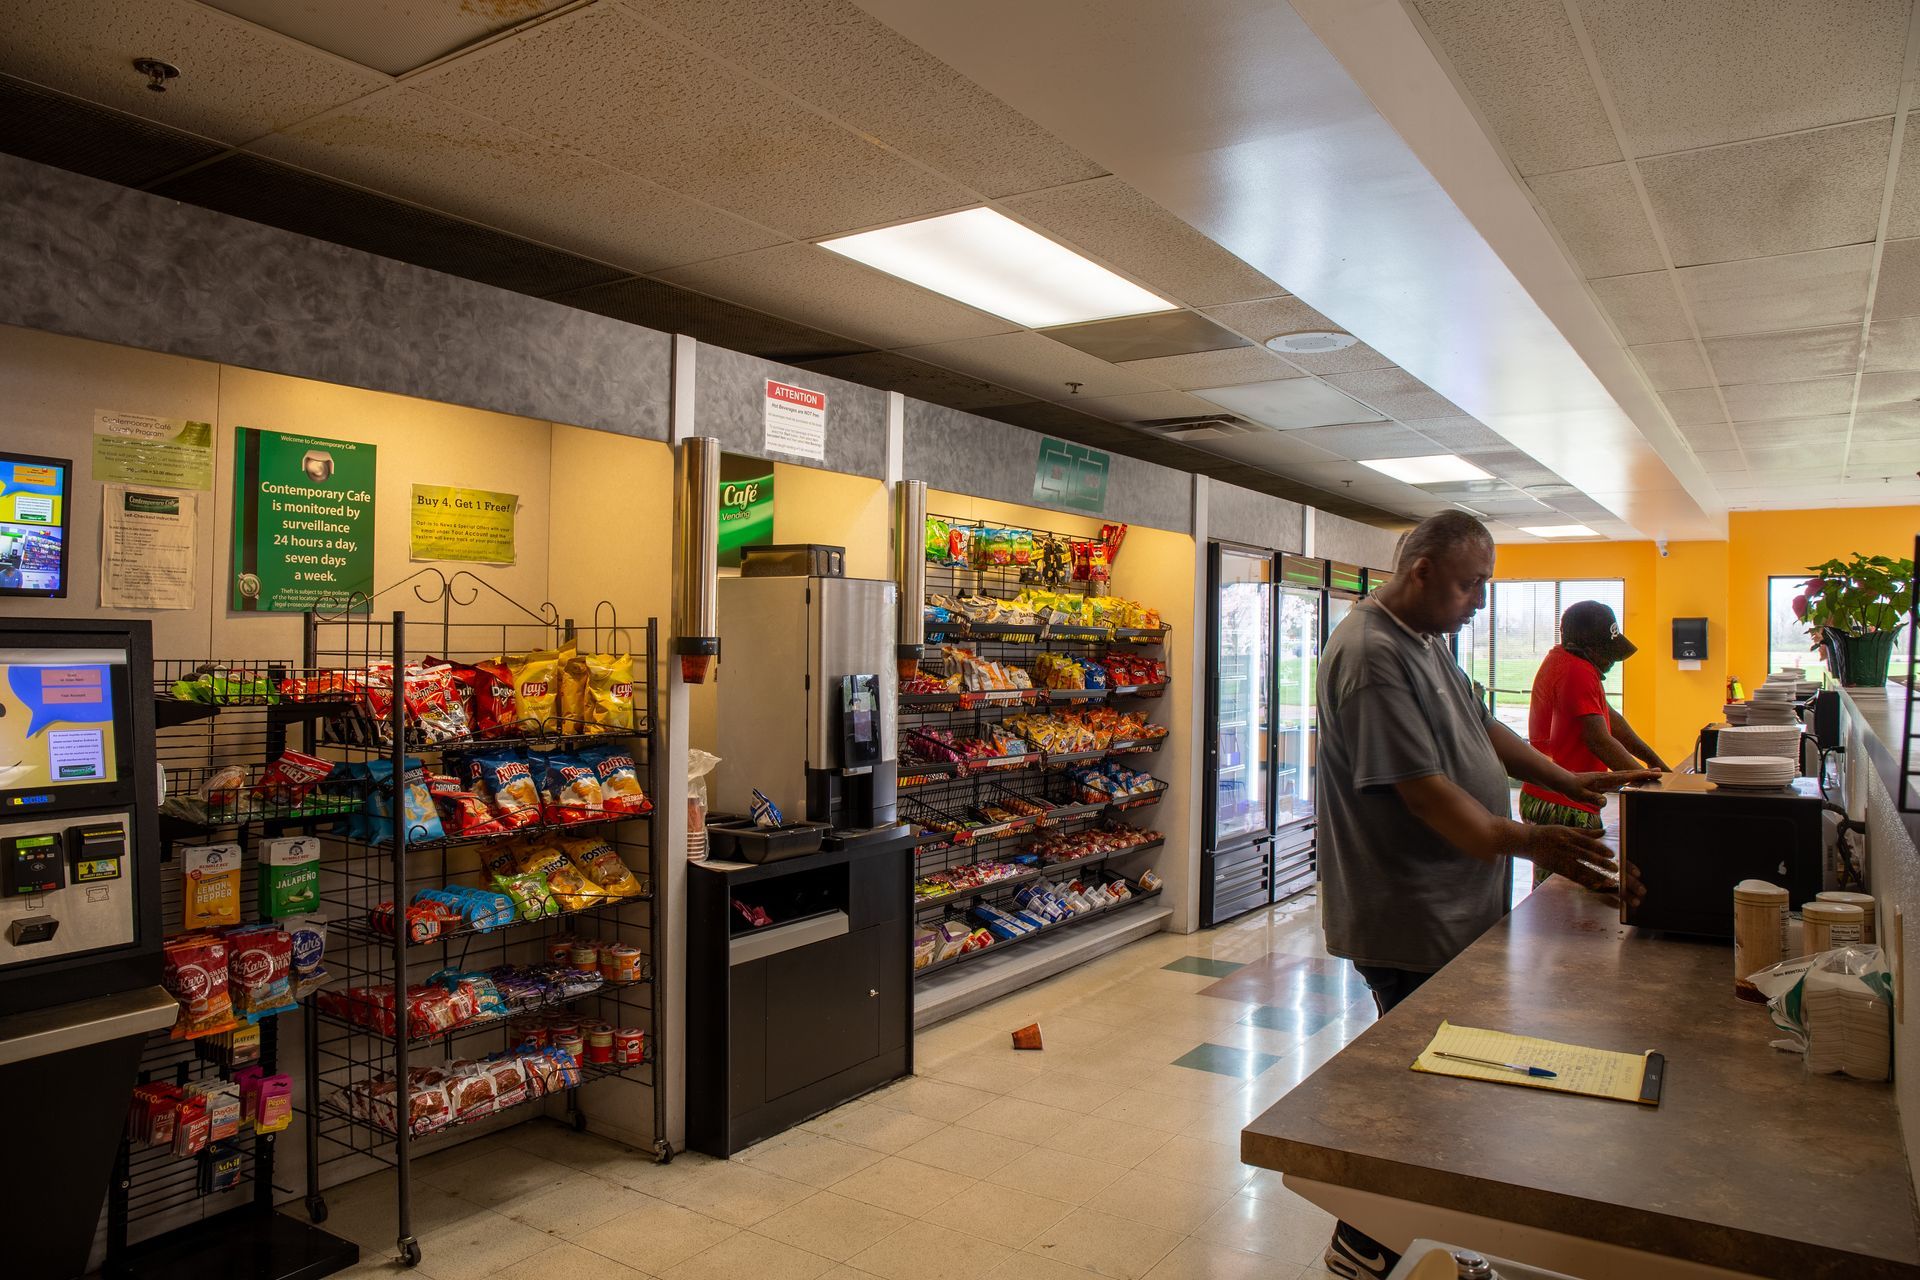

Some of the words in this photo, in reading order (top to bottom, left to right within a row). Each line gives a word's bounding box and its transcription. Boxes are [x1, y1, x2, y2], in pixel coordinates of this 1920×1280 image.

[775, 386, 817, 404] ATTENTION
[136, 429, 164, 437] Program
[280, 435, 304, 443] Welcome
[311, 440, 344, 449] Contemporary
[261, 482, 344, 502] Contemporary
[347, 490, 370, 502] Cafe
[724, 484, 758, 510] Café
[129, 496, 165, 506] Contemporary
[417, 495, 439, 507] Buy
[442, 498, 451, 508] 4,
[455, 499, 473, 509] Get
[477, 501, 481, 509] 1
[484, 502, 510, 512] Free!
[272, 500, 281, 511] is
[285, 502, 343, 516] monitored
[347, 508, 360, 519] by
[722, 511, 750, 520] Vending
[282, 520, 350, 533] surveillance
[274, 534, 288, 545] 24
[291, 535, 323, 548] hours
[326, 540, 332, 548] a
[335, 538, 357, 552] day,
[285, 554, 318, 564] seven
[321, 554, 346, 567] days
[295, 572, 301, 580] a
[304, 571, 337, 581] week.
[523, 683, 546, 697] Lay's
[403, 768, 423, 780] ORNERS
[276, 870, 316, 888] JALAPEÑO
[197, 882, 223, 894] LEMON
[197, 888, 232, 903] PEPPER
[242, 958, 270, 975] Kar's
[180, 974, 204, 990] Kar's
[219, 1158, 239, 1171] Advil
